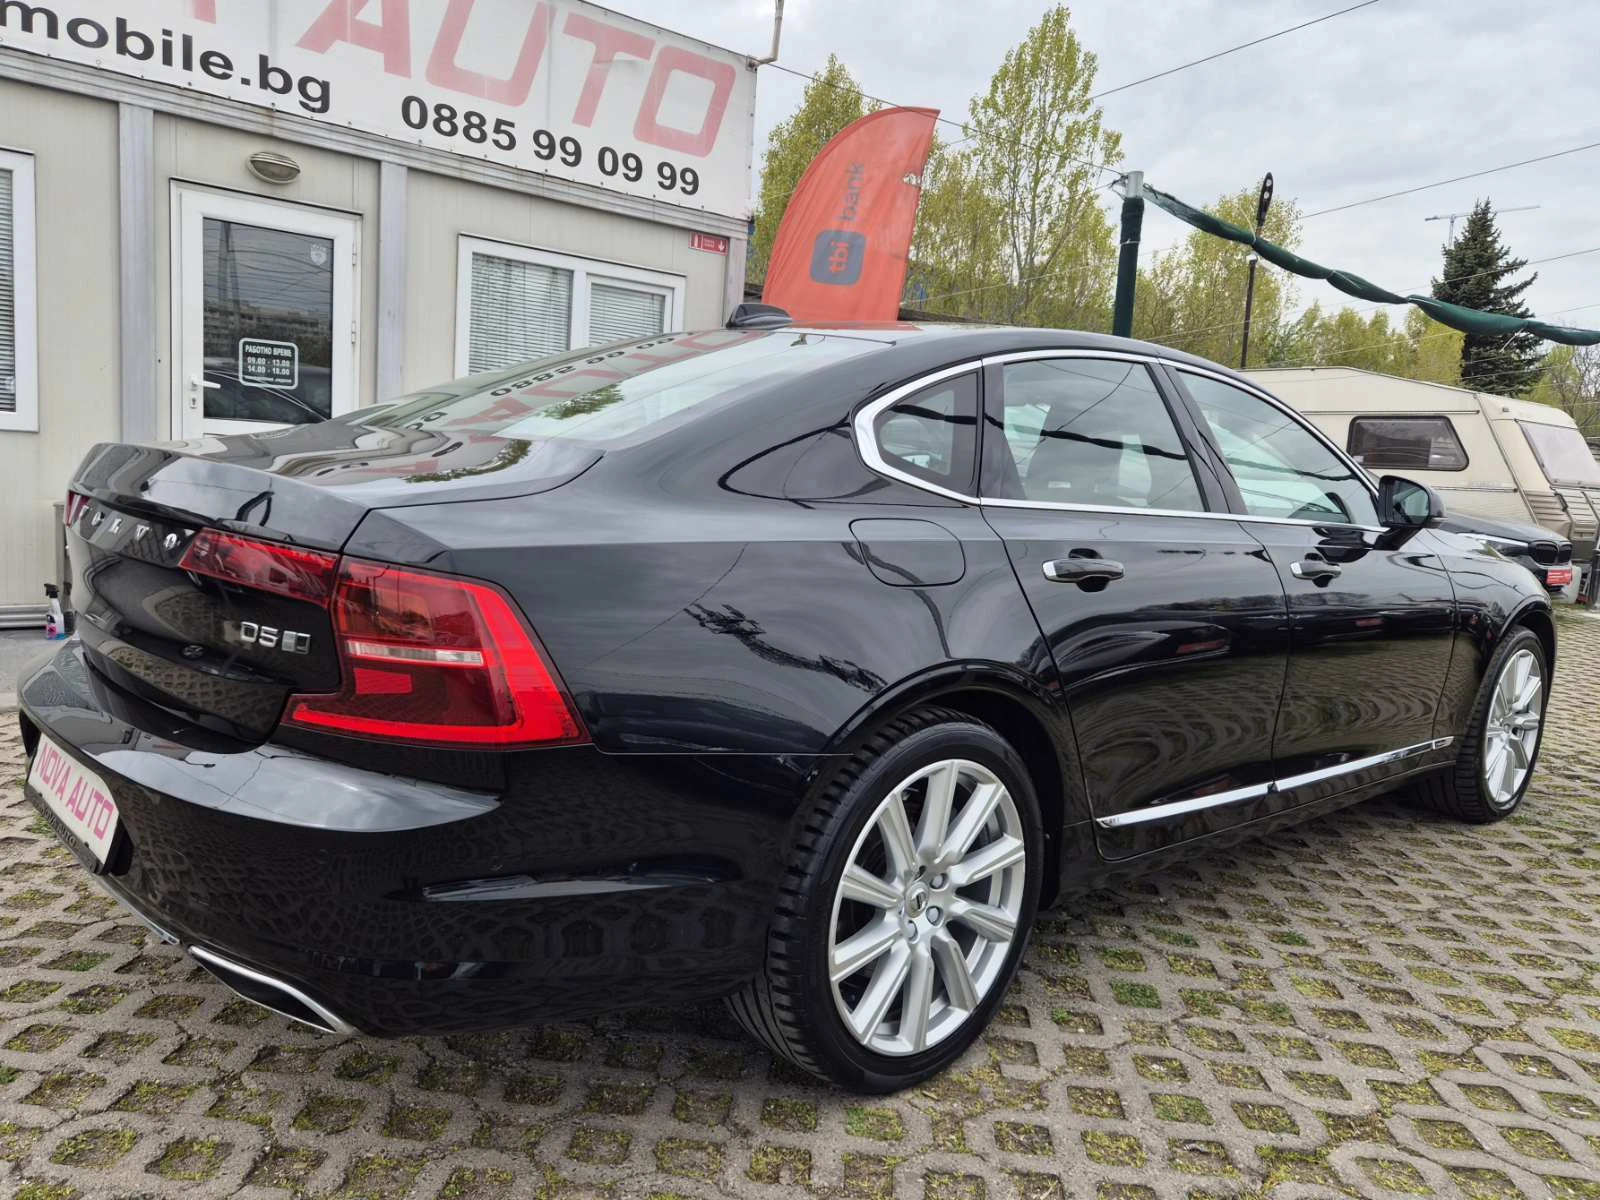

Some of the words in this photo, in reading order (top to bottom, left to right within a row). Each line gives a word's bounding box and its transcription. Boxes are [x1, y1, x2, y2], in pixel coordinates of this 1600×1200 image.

[0, 0, 330, 113] mobile.bg
[296, 0, 737, 158] AUTO
[401, 95, 517, 151] 0885
[532, 129, 582, 167] 99
[597, 146, 643, 182] 09
[657, 161, 700, 195] 99
[837, 162, 864, 223] bank
[828, 241, 849, 273] tbi
[79, 504, 178, 551] VOLVO
[240, 621, 278, 648] D5
[36, 742, 71, 800] NOVA
[66, 775, 114, 841] AUTO
